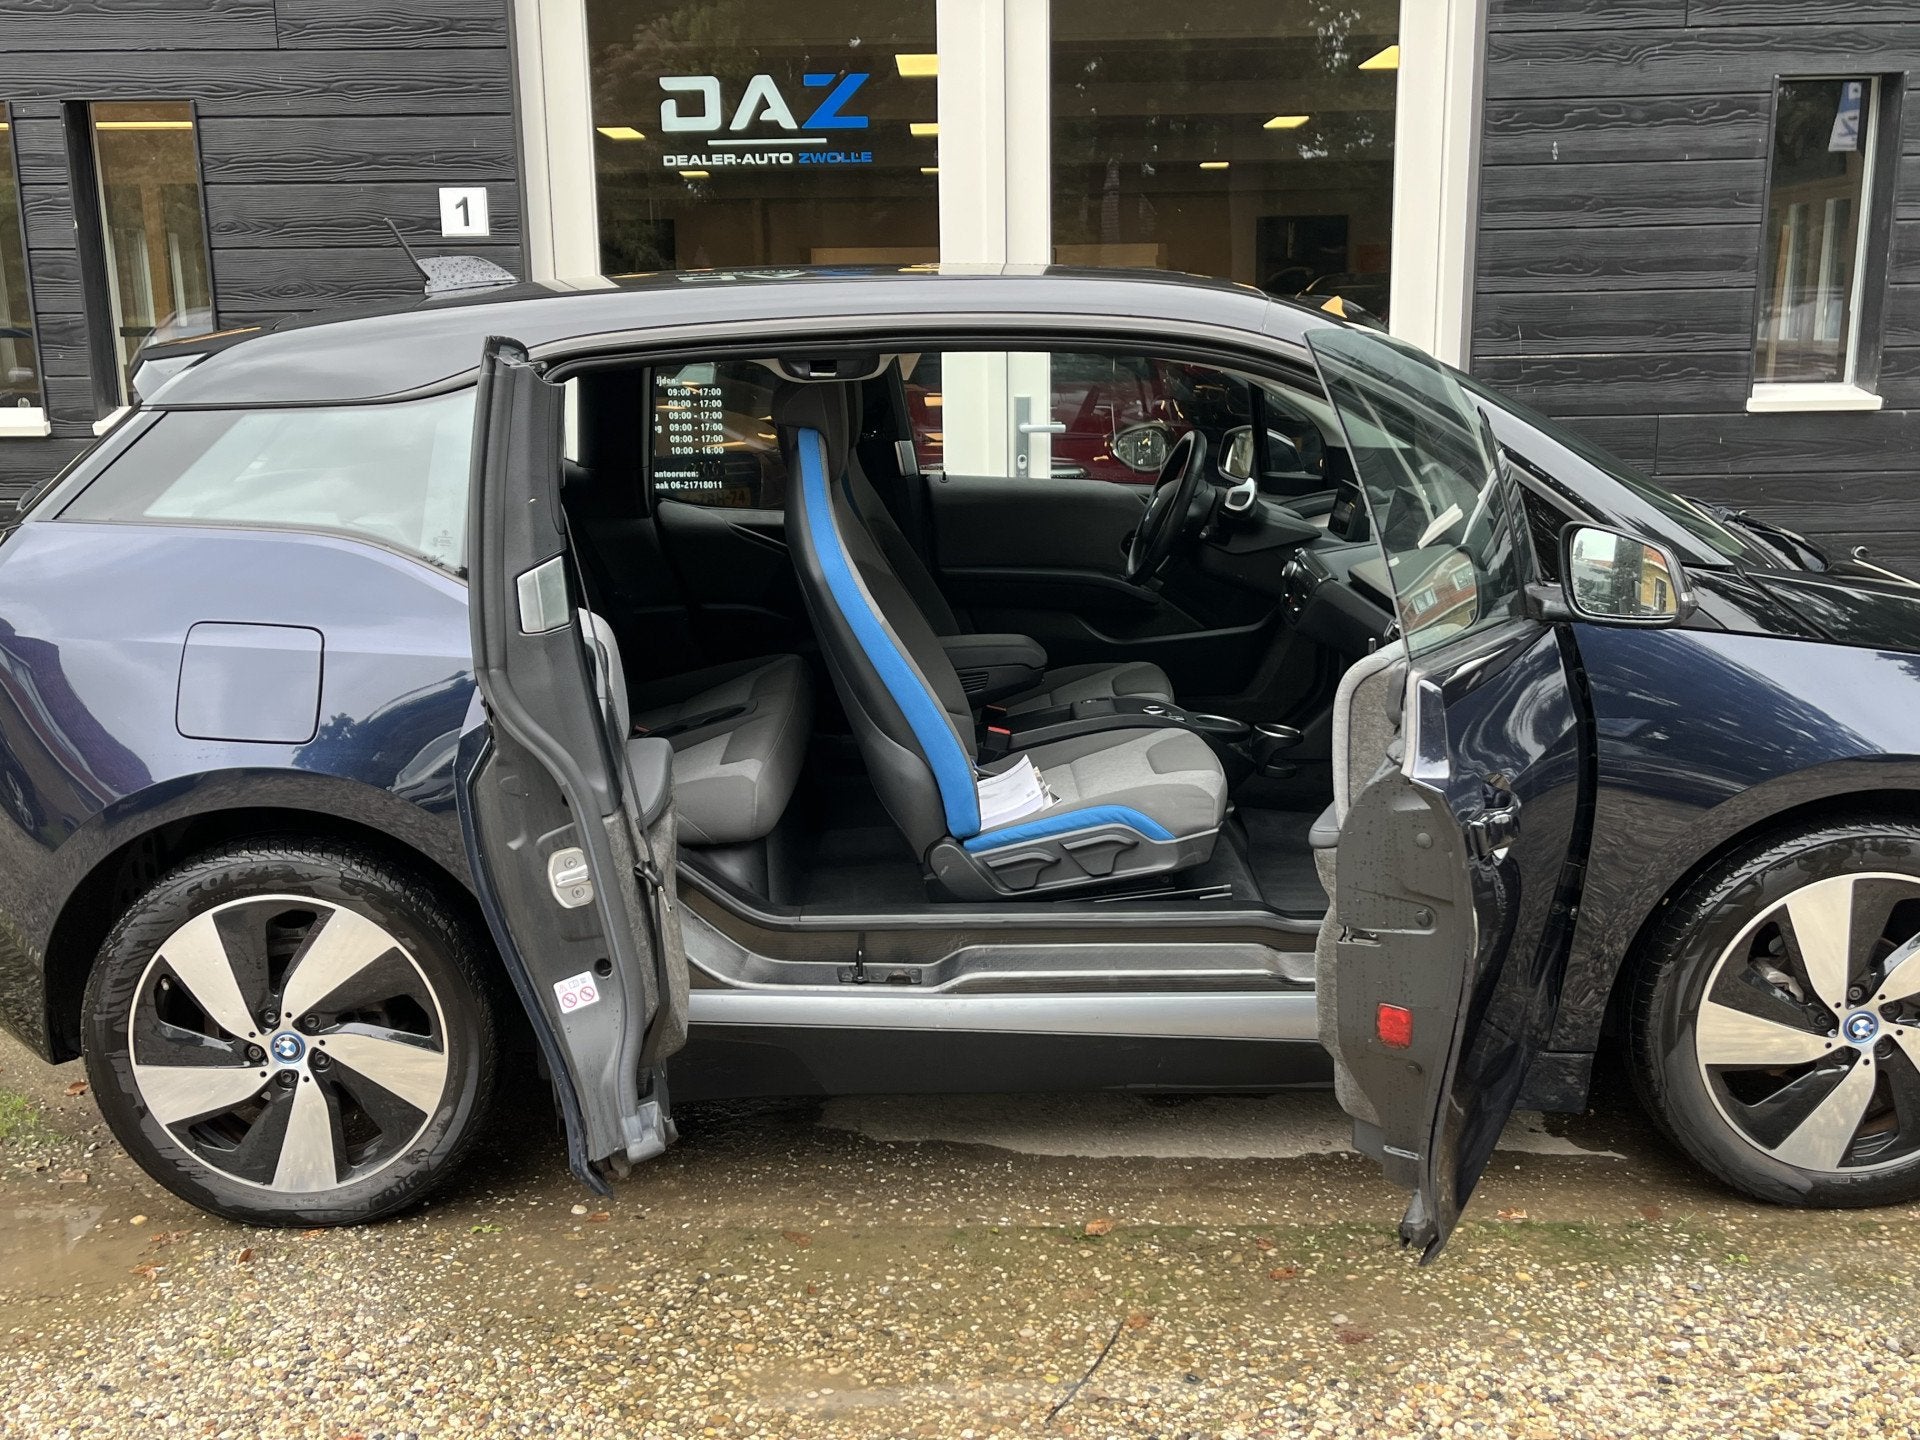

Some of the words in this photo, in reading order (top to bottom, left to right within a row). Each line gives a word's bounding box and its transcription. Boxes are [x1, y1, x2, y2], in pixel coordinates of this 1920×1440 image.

[659, 73, 870, 132] DAZ
[663, 152, 793, 167] DEALER-AUTO
[799, 152, 873, 164] ZWOLLE
[455, 196, 470, 227] 1
[667, 388, 690, 396] 09:00
[699, 388, 722, 396] 17:00
[699, 400, 723, 408] 17:00
[668, 412, 692, 420] 09:00
[700, 411, 723, 420] 17:00
[669, 423, 692, 432] 09:00
[700, 423, 723, 431] 17:00
[670, 435, 693, 443] 09:00
[701, 434, 724, 443] 17:00
[671, 447, 693, 455] 10:00
[701, 446, 724, 455] 16:00
[670, 481, 722, 489] 06-21718011
